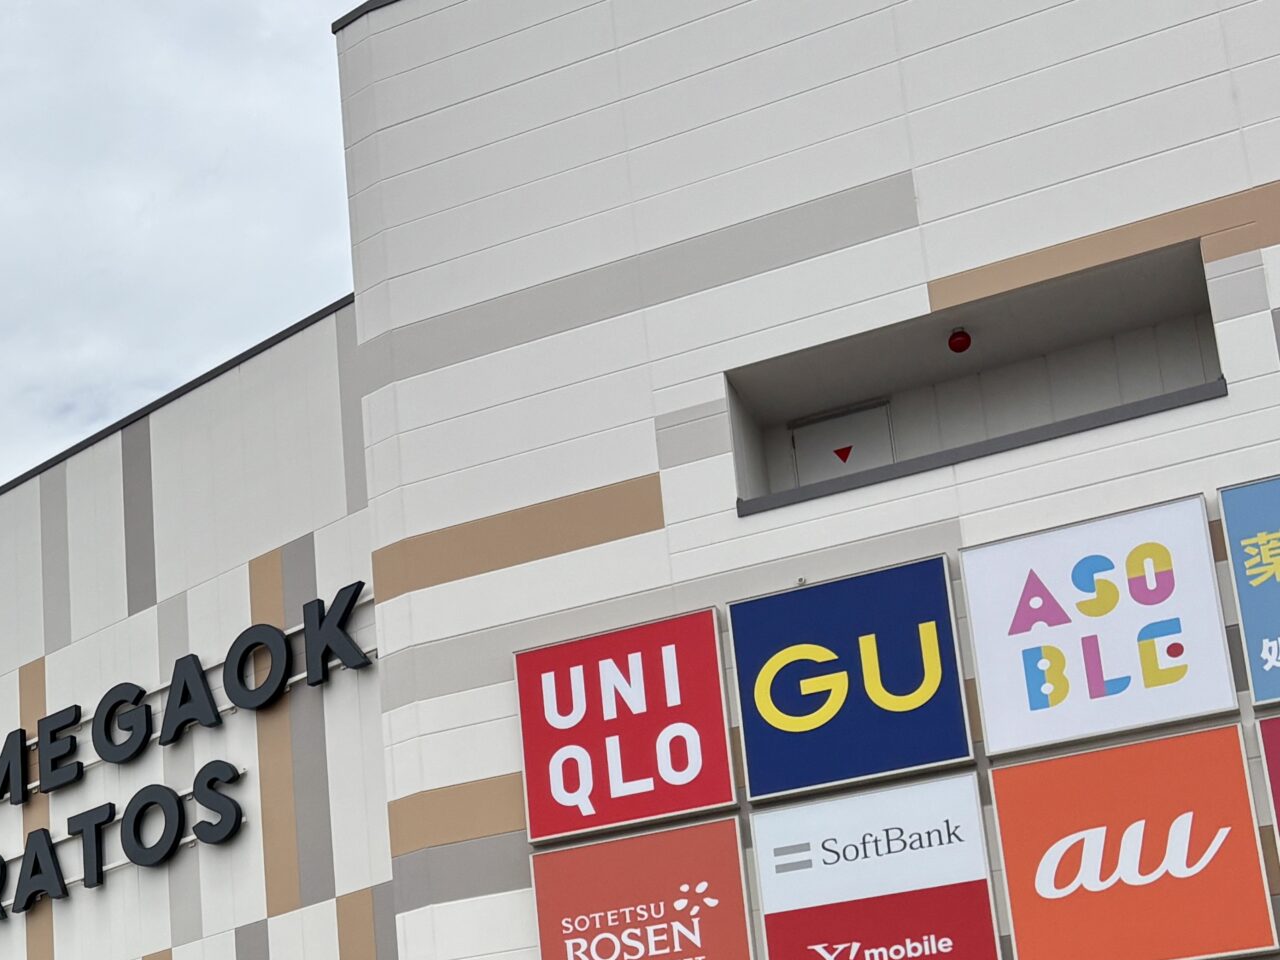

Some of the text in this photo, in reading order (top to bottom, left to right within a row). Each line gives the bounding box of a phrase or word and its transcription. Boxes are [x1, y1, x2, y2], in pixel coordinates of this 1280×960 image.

[1007, 541, 1176, 636] ASO
[541, 644, 681, 730] UNI
[753, 621, 944, 733] GU
[1021, 617, 1189, 711] BLE
[549, 722, 703, 817] QLO
[820, 818, 965, 865] SoftBank
[1034, 811, 1232, 899] au
[561, 901, 665, 934] SOTETSU
